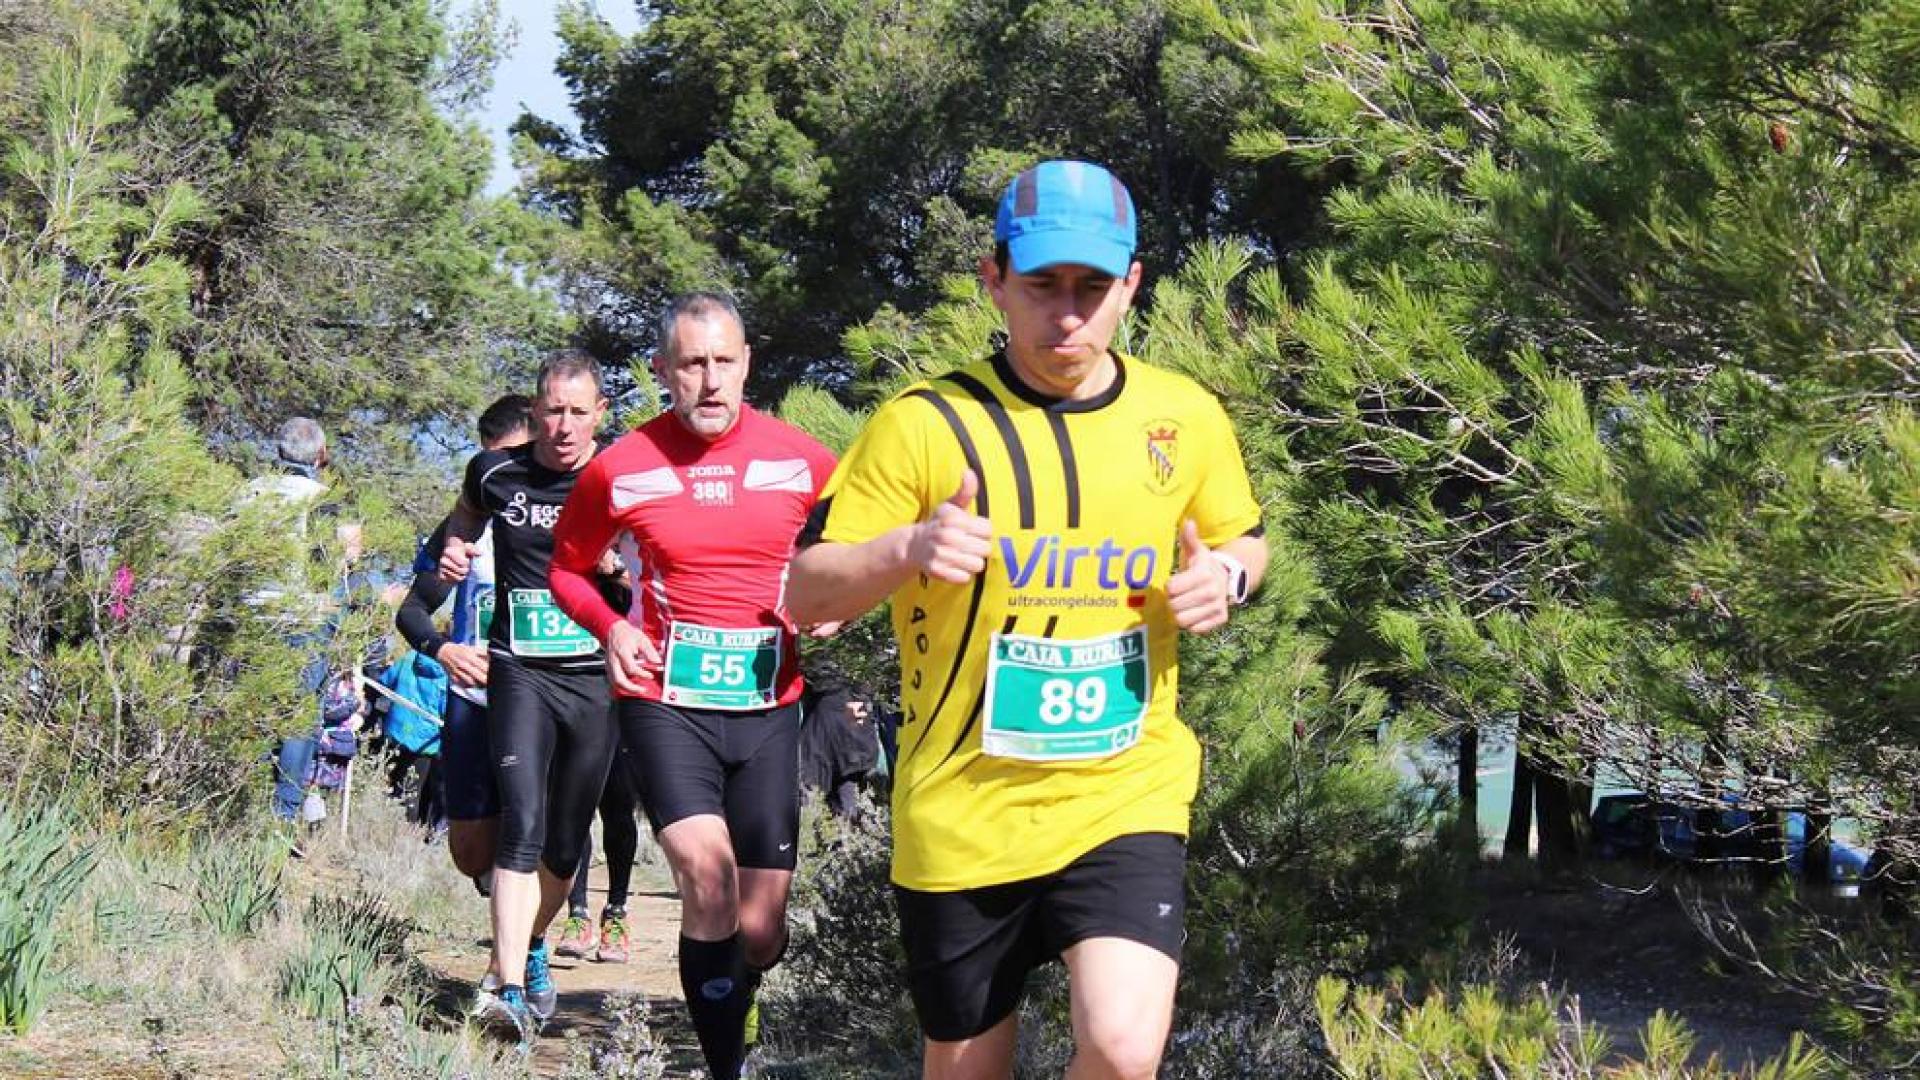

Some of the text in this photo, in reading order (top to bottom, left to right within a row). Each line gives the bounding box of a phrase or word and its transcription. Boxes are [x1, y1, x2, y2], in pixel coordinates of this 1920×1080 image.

[999, 536, 1156, 589] Virto
[1008, 594, 1118, 609] ultracongelados
[527, 610, 581, 637] 132
[1073, 637, 1139, 666] RURAL
[701, 653, 746, 685] 55
[1039, 677, 1106, 725] 89
